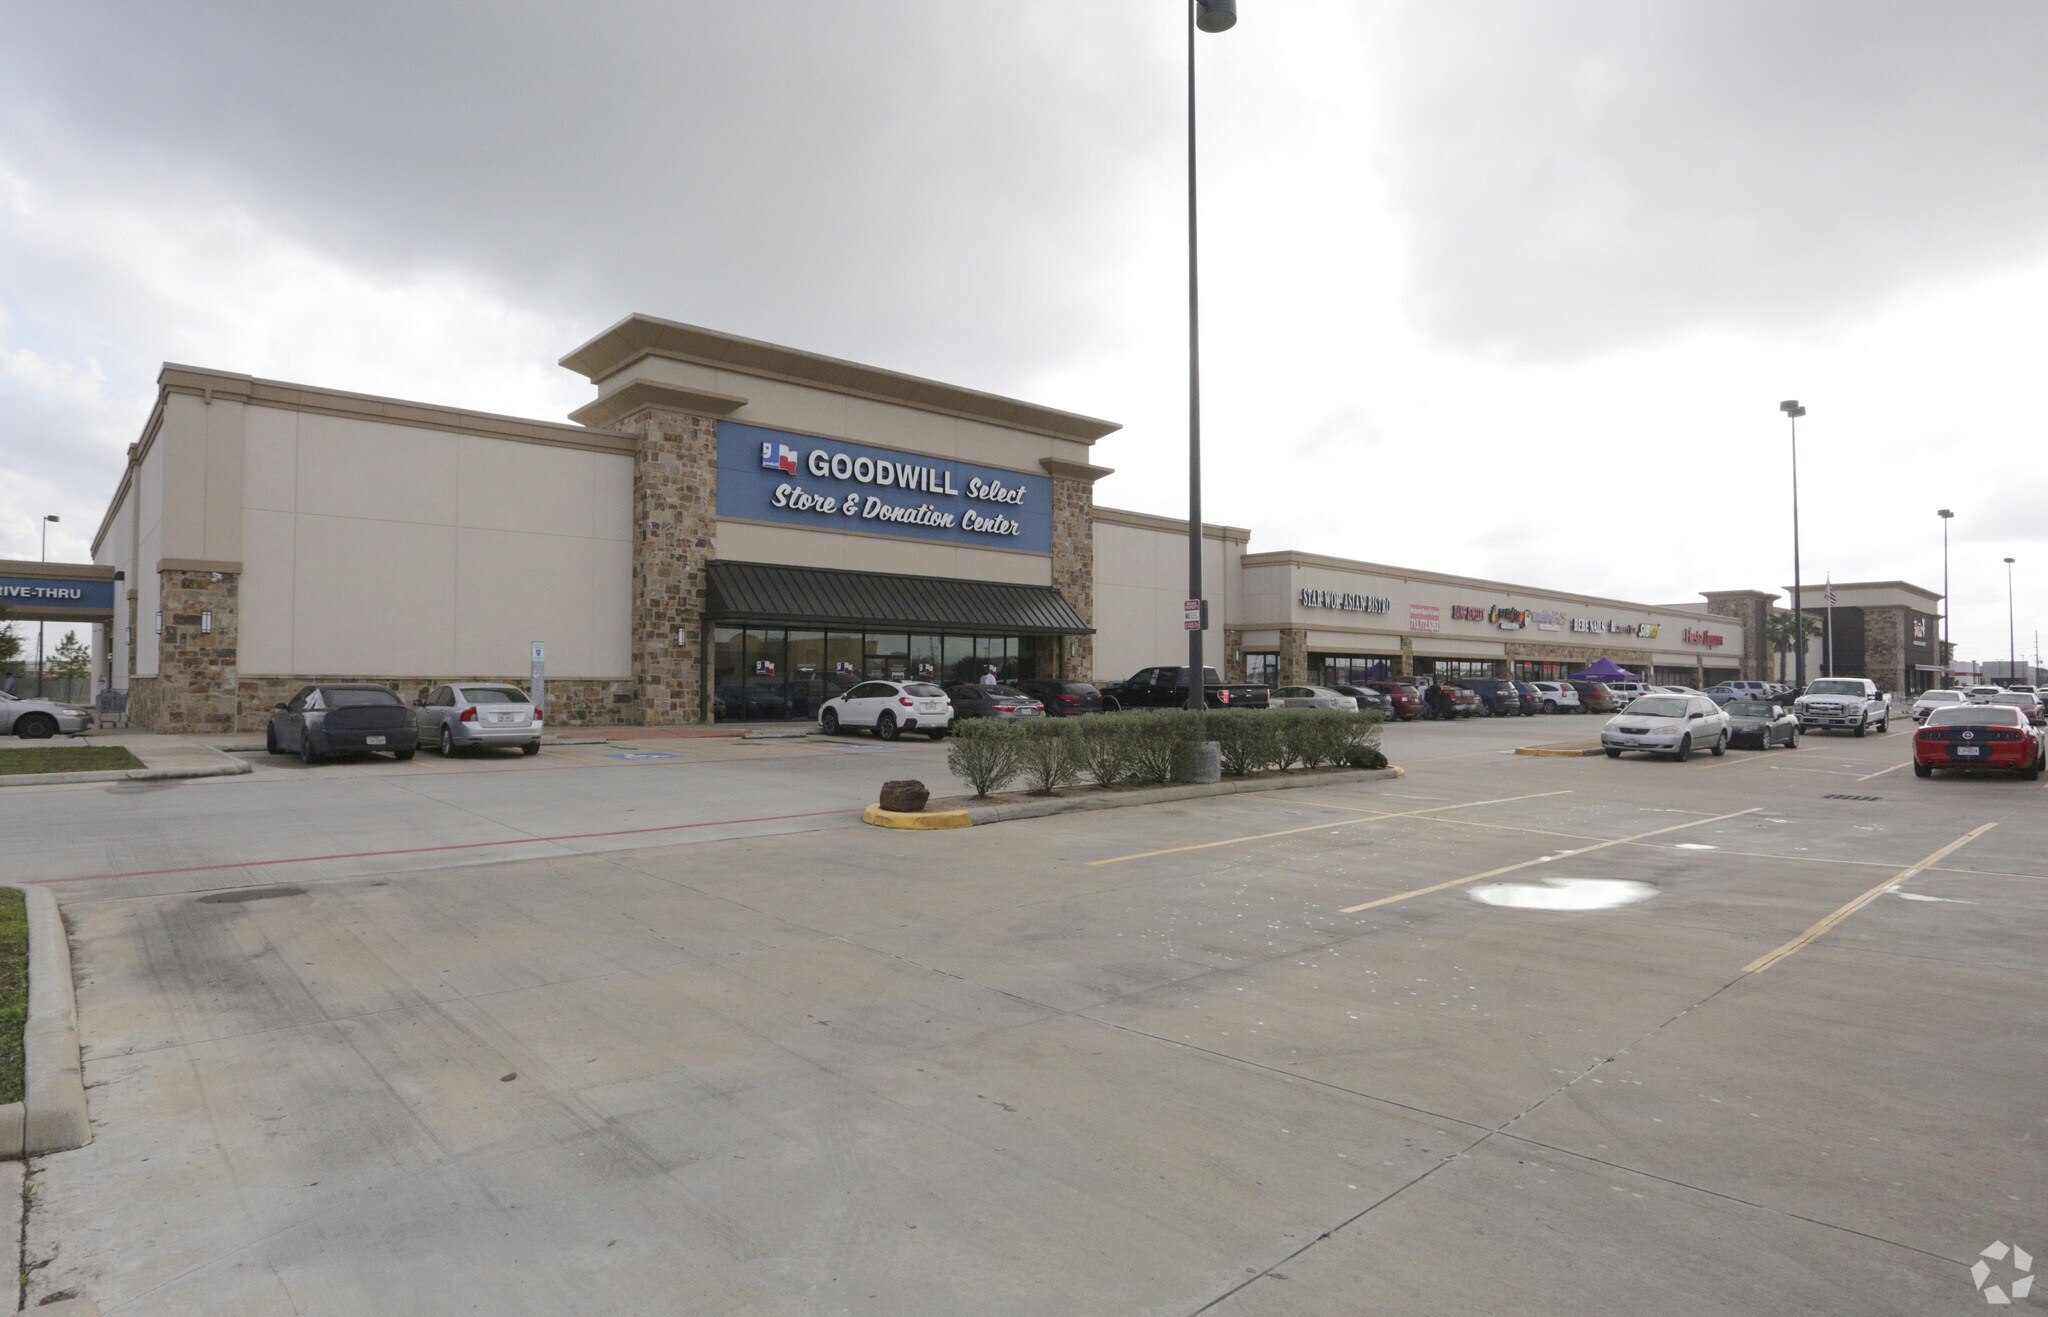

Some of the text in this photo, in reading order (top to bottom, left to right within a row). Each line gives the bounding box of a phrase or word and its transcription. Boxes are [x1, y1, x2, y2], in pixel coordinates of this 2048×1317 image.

[808, 449, 1027, 505] GOODWILL Select
[771, 483, 1021, 536] Store & Donation Center
[0, 586, 81, 599] IVE-THRU
[1303, 588, 1322, 607] STAR
[1343, 593, 1366, 611] ASIAN
[1367, 595, 1391, 614] BISTRO
[1573, 618, 1590, 632] BEBE
